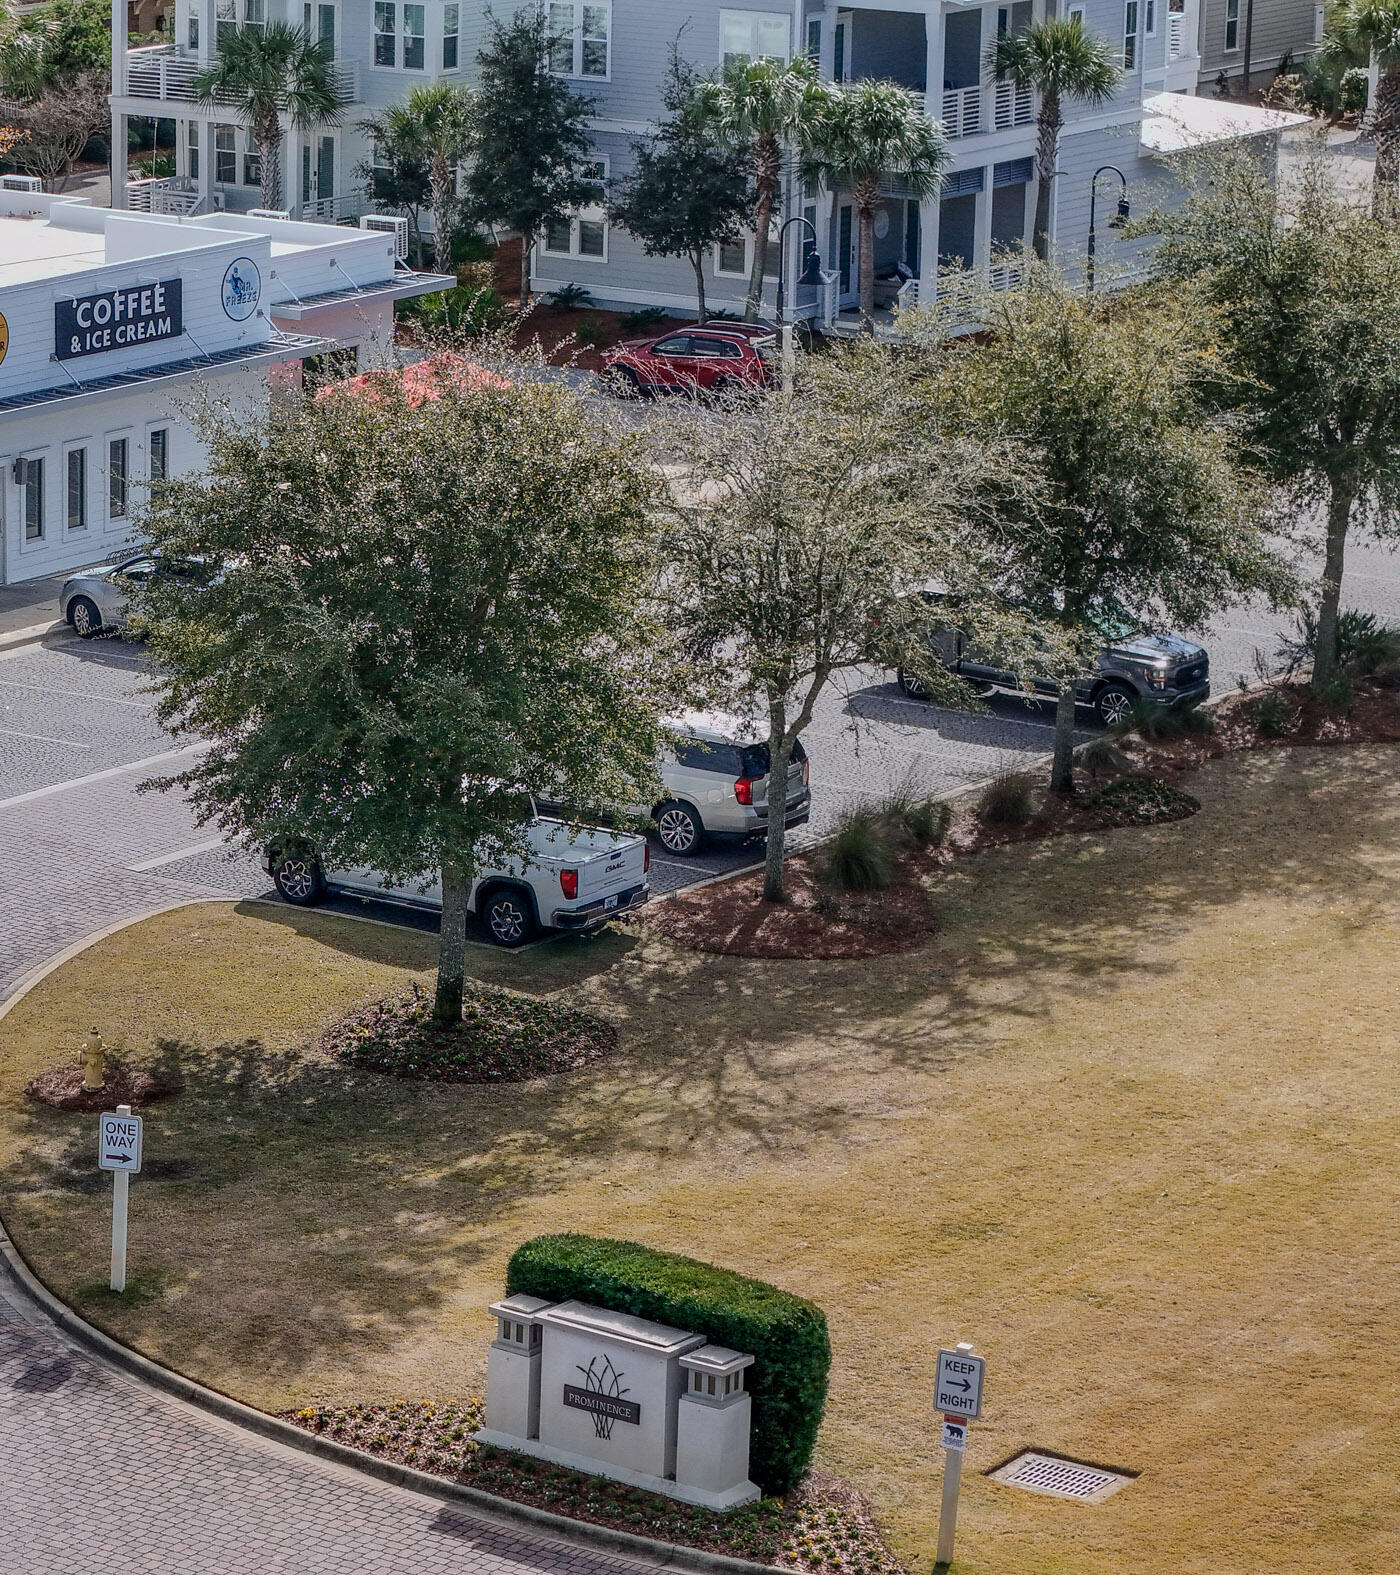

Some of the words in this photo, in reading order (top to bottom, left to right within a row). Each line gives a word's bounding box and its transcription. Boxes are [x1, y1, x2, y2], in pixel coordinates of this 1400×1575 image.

[76, 287, 166, 328] COFFEE
[70, 335, 82, 353] &
[86, 329, 111, 350] ICE
[115, 316, 171, 343] CREAM
[605, 860, 626, 873] GMC
[105, 1121, 137, 1137] ONE
[105, 1134, 136, 1149] WAY
[944, 1359, 975, 1375] KEEP
[568, 1392, 632, 1418] PROMINENCE
[940, 1393, 975, 1410] RIGHT
